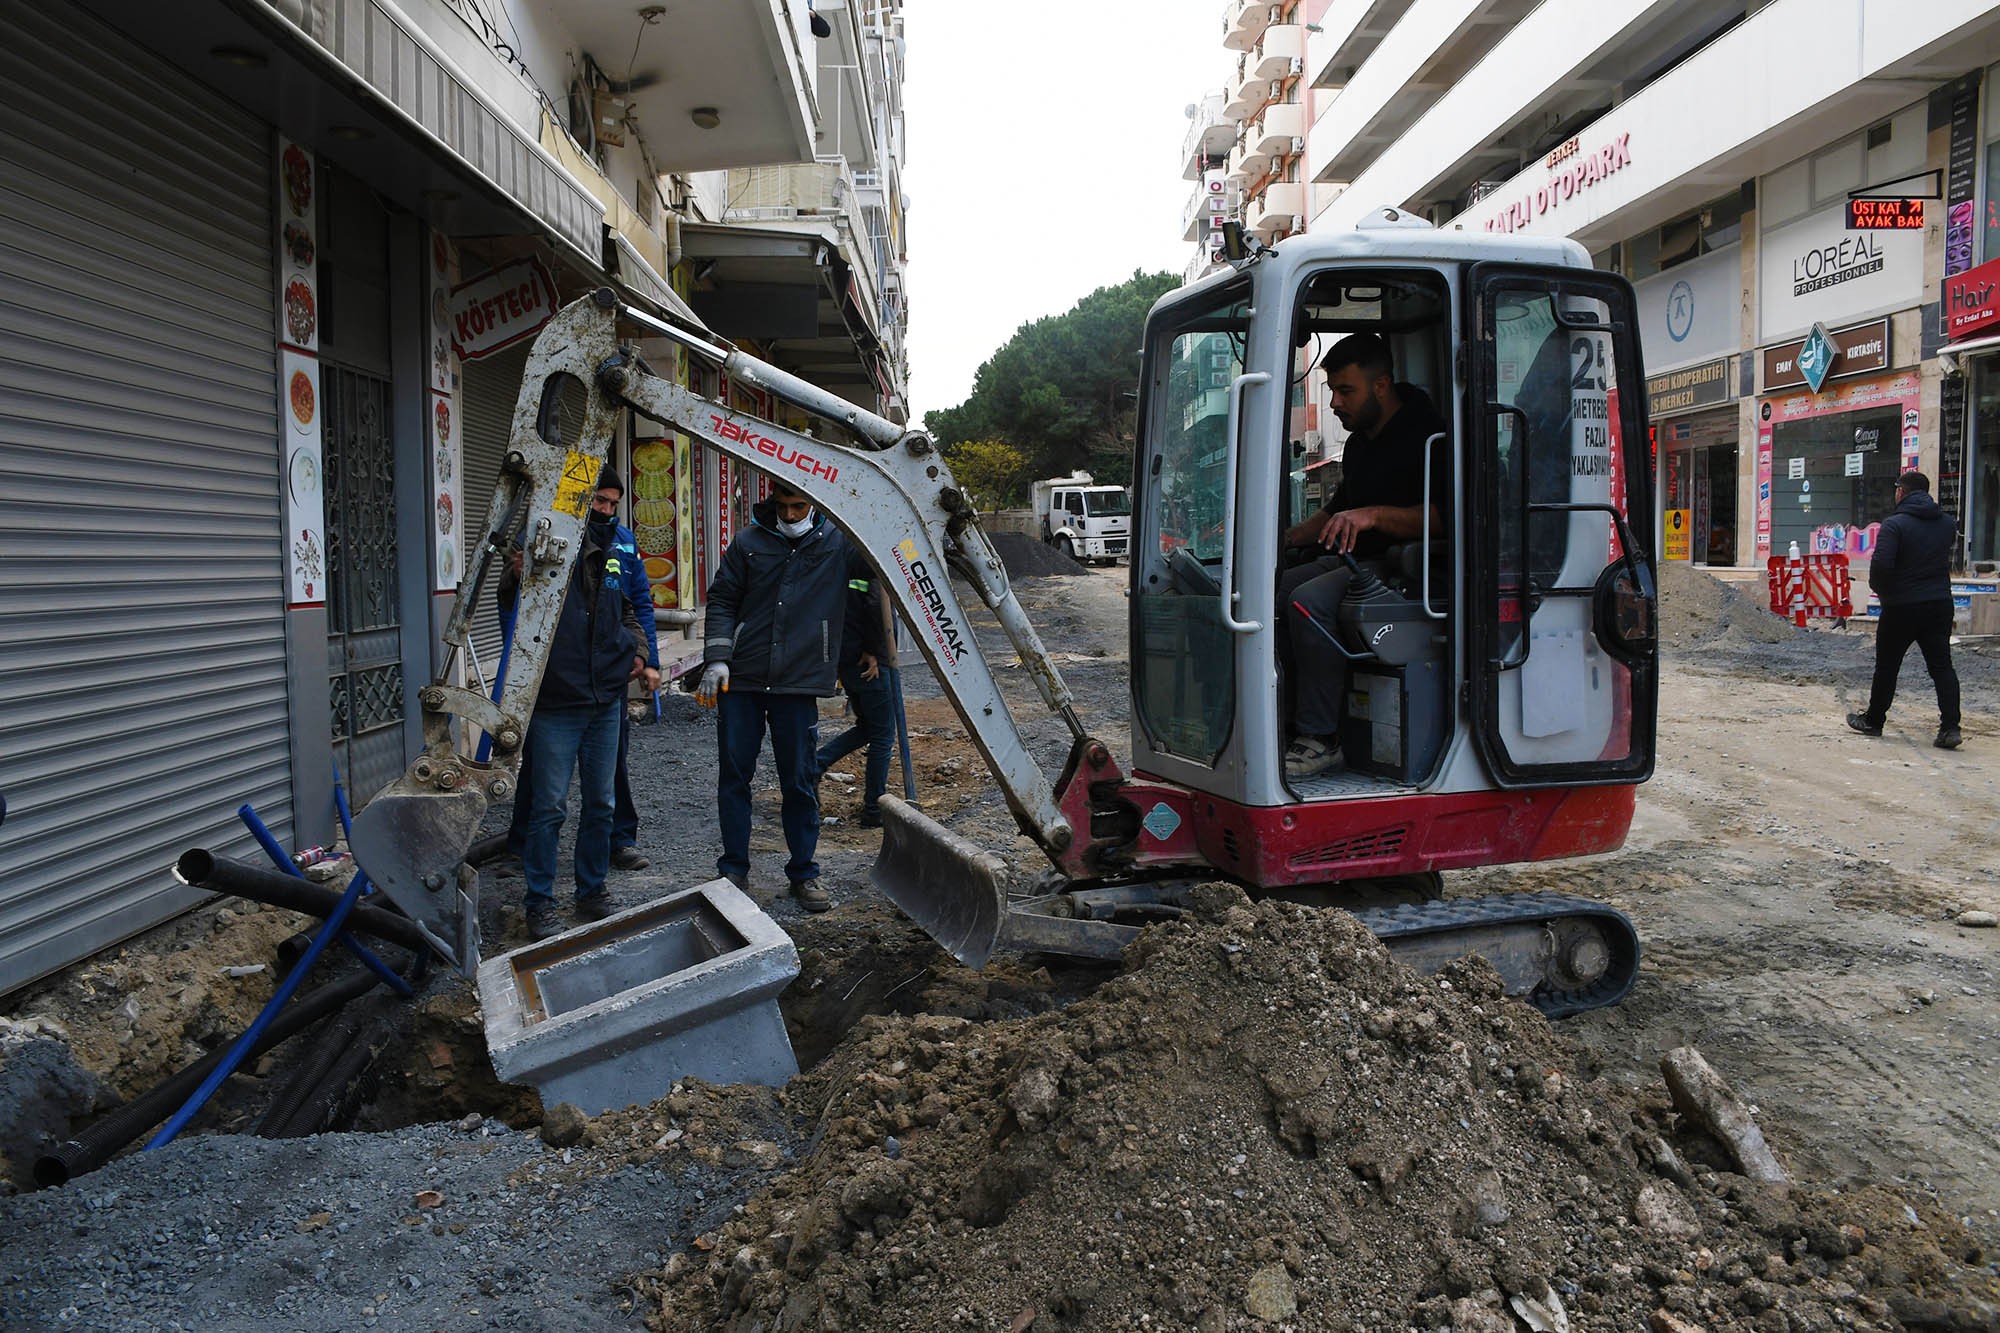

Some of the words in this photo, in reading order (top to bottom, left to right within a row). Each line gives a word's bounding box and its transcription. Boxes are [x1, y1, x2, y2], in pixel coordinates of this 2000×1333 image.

[1536, 132, 1632, 215] OTOPARK
[1211, 181, 1224, 244] OTEL
[1853, 199, 1876, 215] ÜST
[1879, 202, 1901, 214] KAT
[1856, 216, 1892, 227] AYAK
[1897, 216, 1924, 227] BAK
[1794, 232, 1883, 282] L'ORÉAL
[1794, 259, 1883, 296] PROFESSIONNEL
[455, 270, 542, 342] KÖFTECİ
[1952, 282, 1995, 312] Hair
[1847, 339, 1882, 360] KIRTASİYE
[1776, 359, 1793, 374] EMAY
[1660, 387, 1694, 412] MERKEZİ
[910, 560, 969, 661] CERMAK
